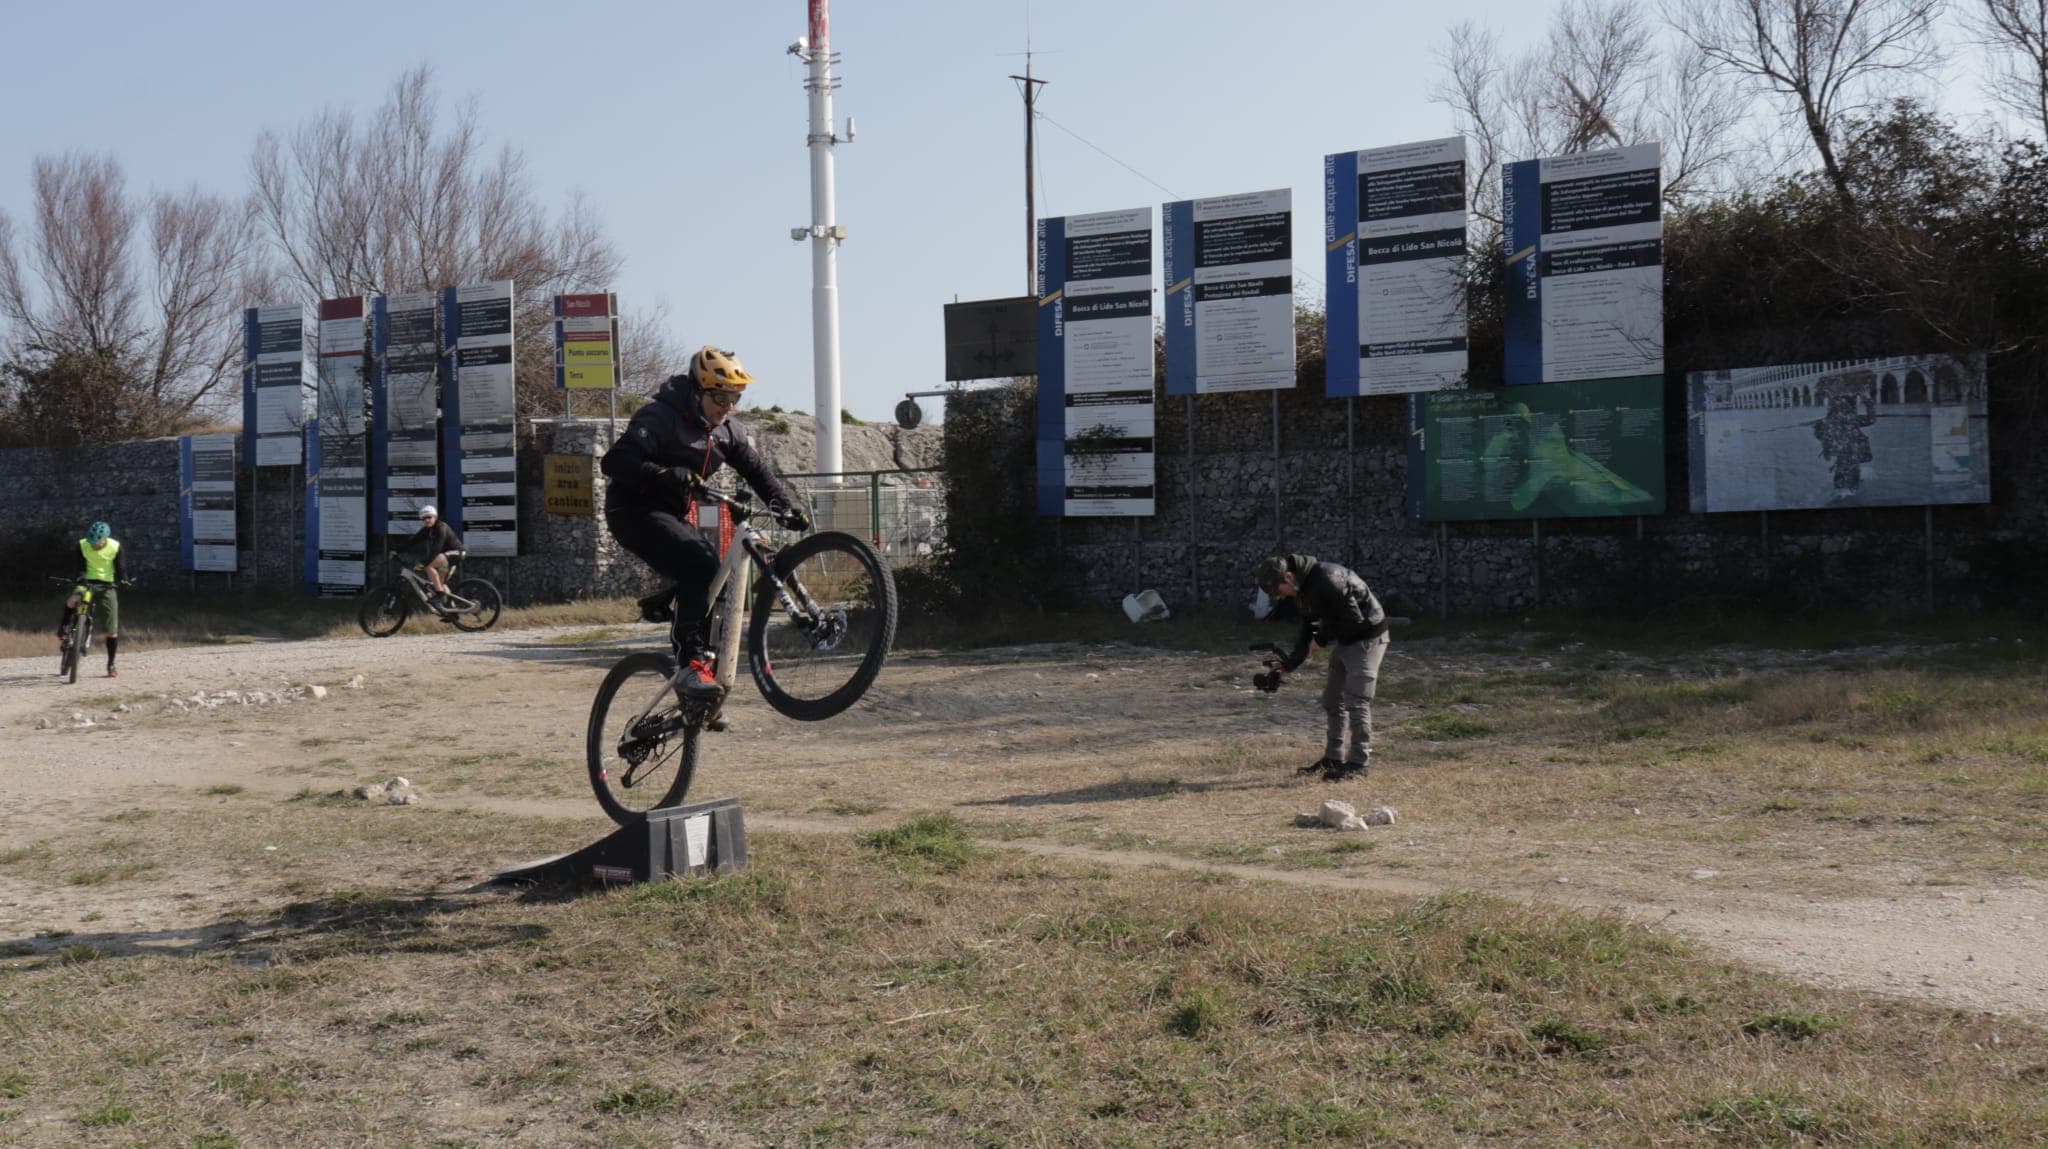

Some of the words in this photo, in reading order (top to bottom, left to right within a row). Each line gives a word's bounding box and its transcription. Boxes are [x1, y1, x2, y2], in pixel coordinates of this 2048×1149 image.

[1326, 178, 1337, 212] acque
[1504, 187, 1516, 224] acque
[1165, 224, 1175, 258] acque
[1325, 215, 1336, 242] dalle
[1503, 227, 1514, 256] dalle
[1039, 240, 1048, 272] acque
[1346, 240, 1356, 283] DIFESA
[1368, 247, 1391, 256] Bocca
[1392, 245, 1400, 253] di
[1402, 243, 1418, 251] Lido
[1420, 242, 1435, 250] San
[1437, 238, 1463, 248] Nicolò
[1164, 260, 1173, 287] dalle
[1055, 297, 1063, 337] DIFESA
[1092, 303, 1098, 311] di
[1100, 303, 1114, 311] Lido
[1184, 285, 1193, 327] DIFESA
[557, 480, 579, 489] area
[547, 496, 589, 508] cantiere
